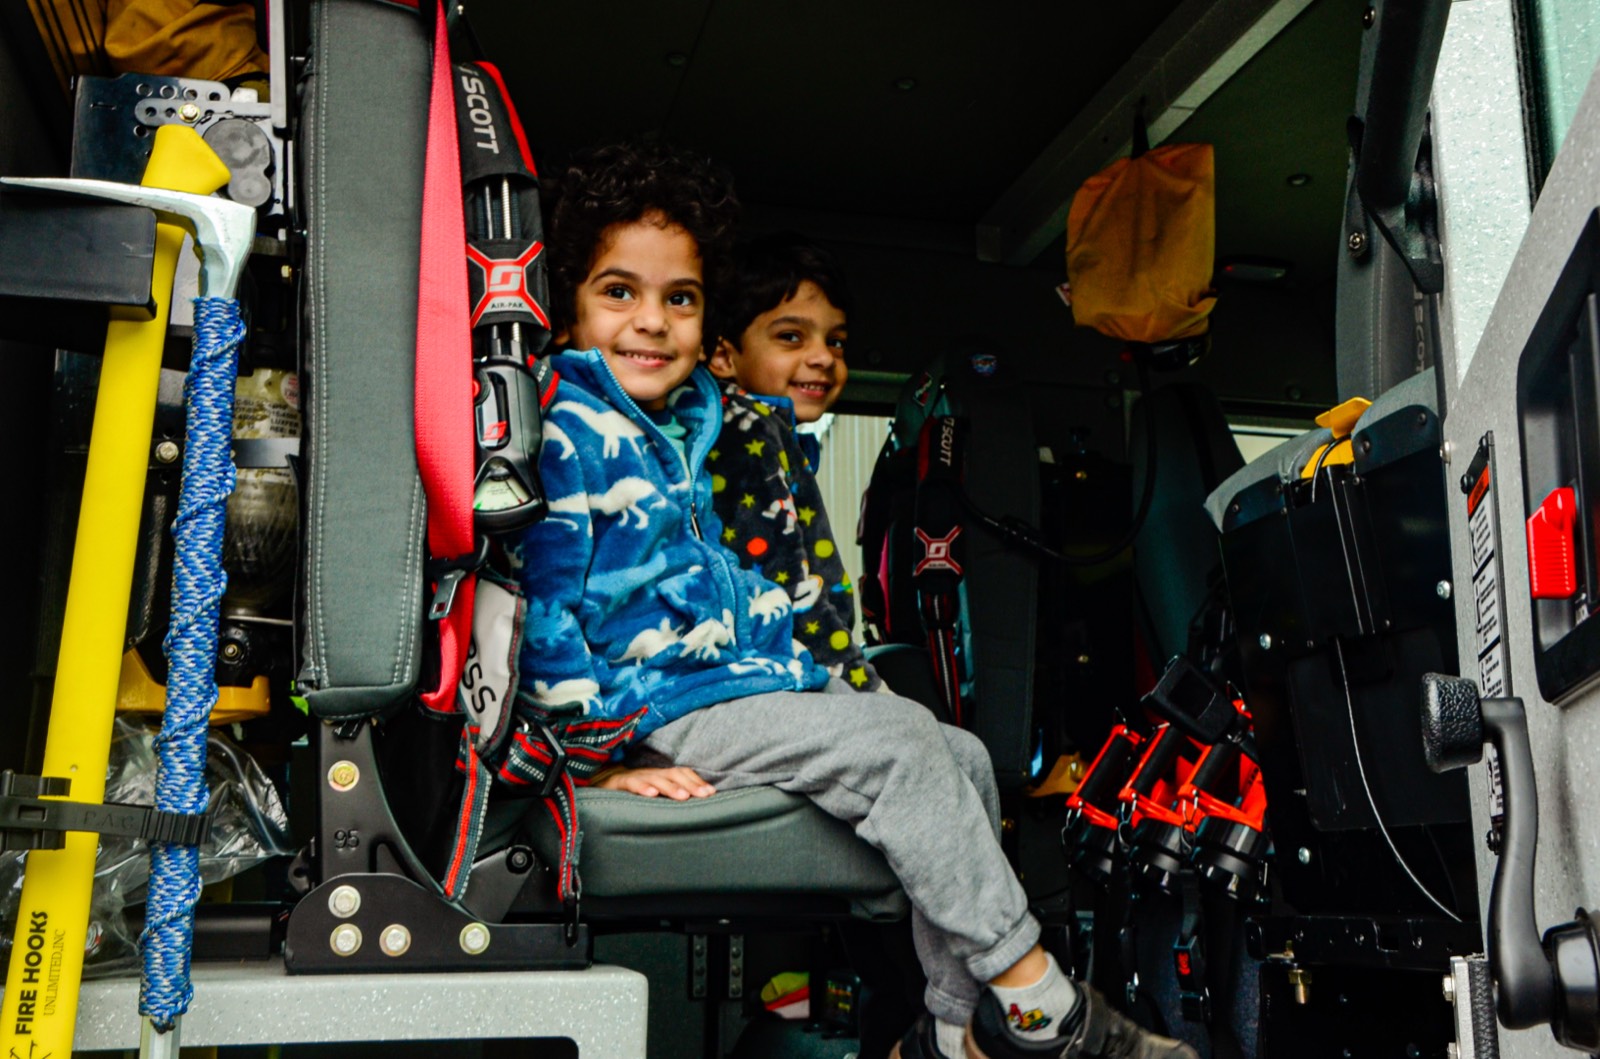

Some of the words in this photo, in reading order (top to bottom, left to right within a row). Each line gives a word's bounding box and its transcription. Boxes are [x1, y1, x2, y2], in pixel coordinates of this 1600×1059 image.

[461, 75, 500, 154] SCOTT
[491, 302, 524, 310] AIR-PAK
[1414, 304, 1425, 373] SCOT
[940, 424, 954, 467] SCOTT
[334, 830, 360, 849] 95
[22, 911, 48, 984] HOOKS
[15, 989, 38, 1035] FIRE
